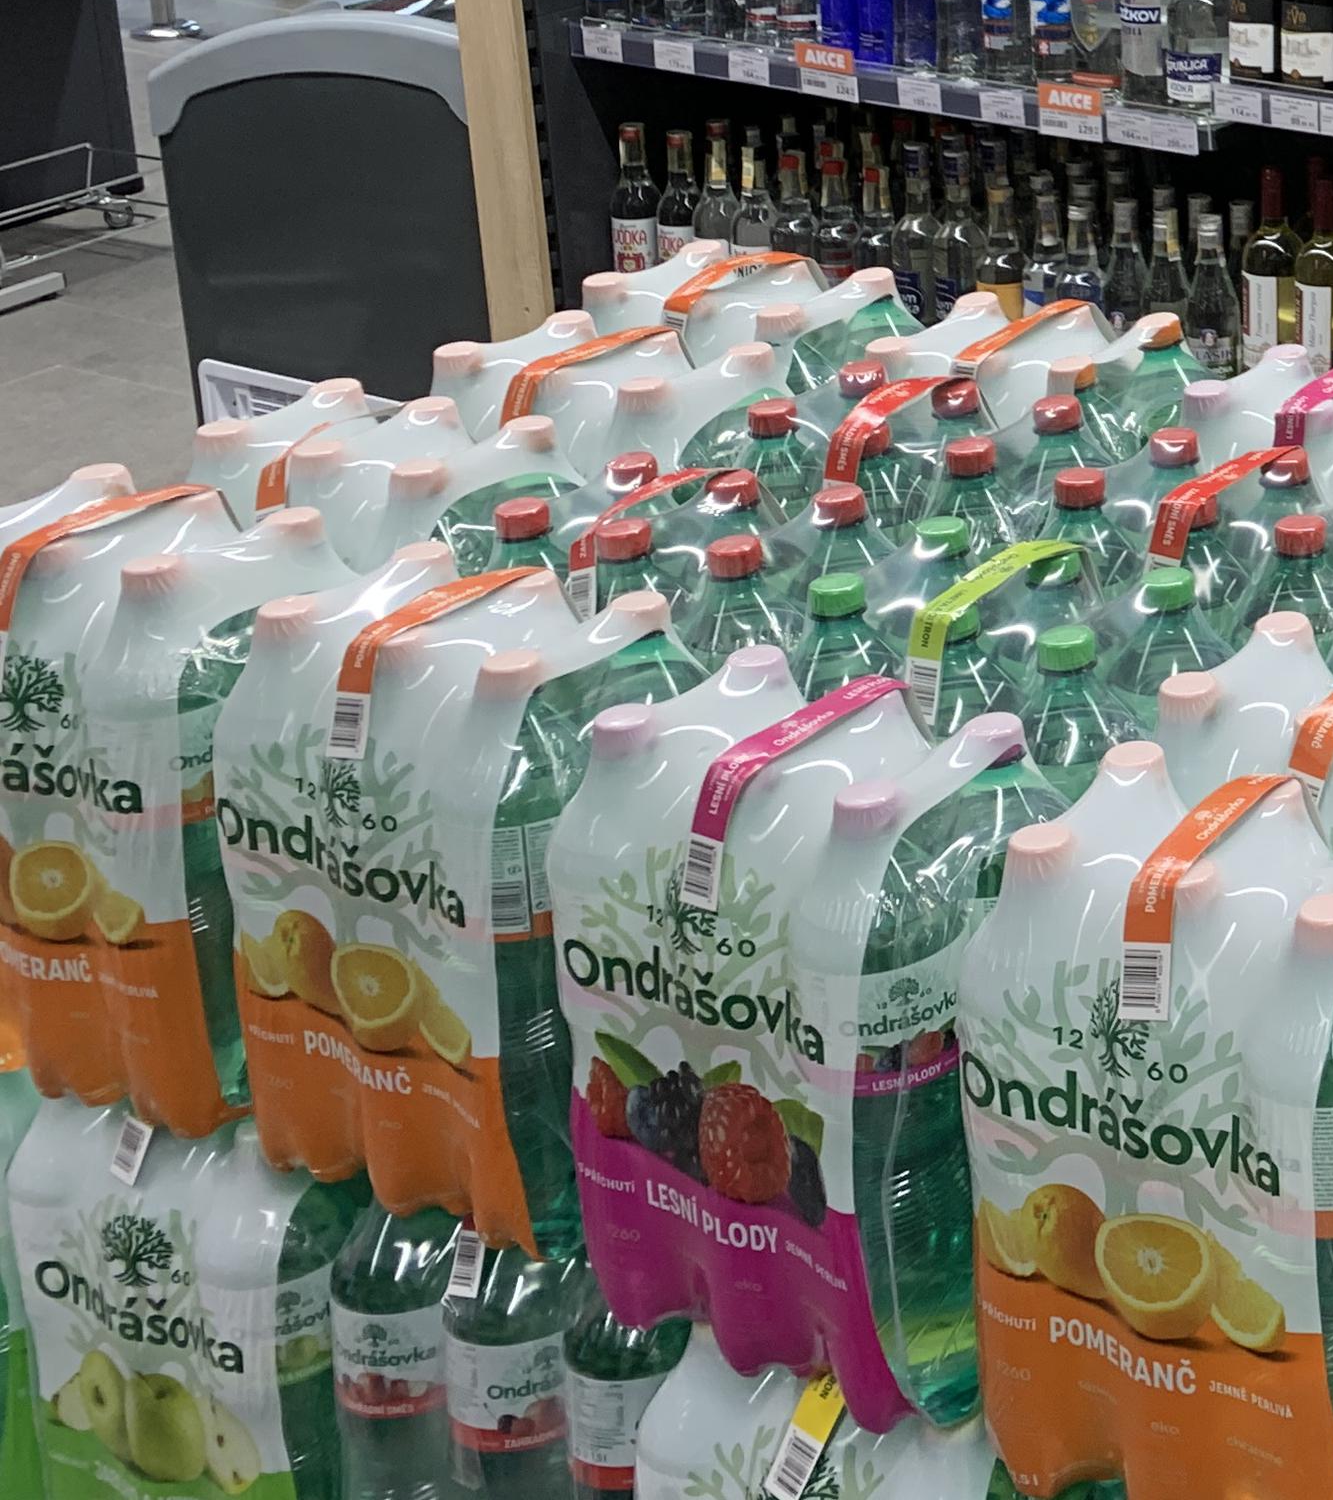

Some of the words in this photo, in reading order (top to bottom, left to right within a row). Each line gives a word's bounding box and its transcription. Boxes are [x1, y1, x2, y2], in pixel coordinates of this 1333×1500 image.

[805, 50, 846, 70] AKCE
[1048, 90, 1093, 111] AKCE
[218, 799, 466, 929] Ondrášovka
[716, 936, 756, 959] 60
[562, 937, 825, 1066] Ondrášovka
[303, 1028, 413, 1095] POMERANČ
[871, 1073, 904, 1094] LESNÍ
[906, 1062, 943, 1087] PLODY
[1052, 1024, 1084, 1050] 12
[1147, 1061, 1189, 1084] 60
[963, 1049, 1281, 1198] Ondrášovka
[646, 1179, 698, 1229] LESNÍ
[701, 1208, 779, 1255] PLODY
[36, 1259, 246, 1375] Ondrášovka
[1049, 1314, 1197, 1396] POMERANČ
